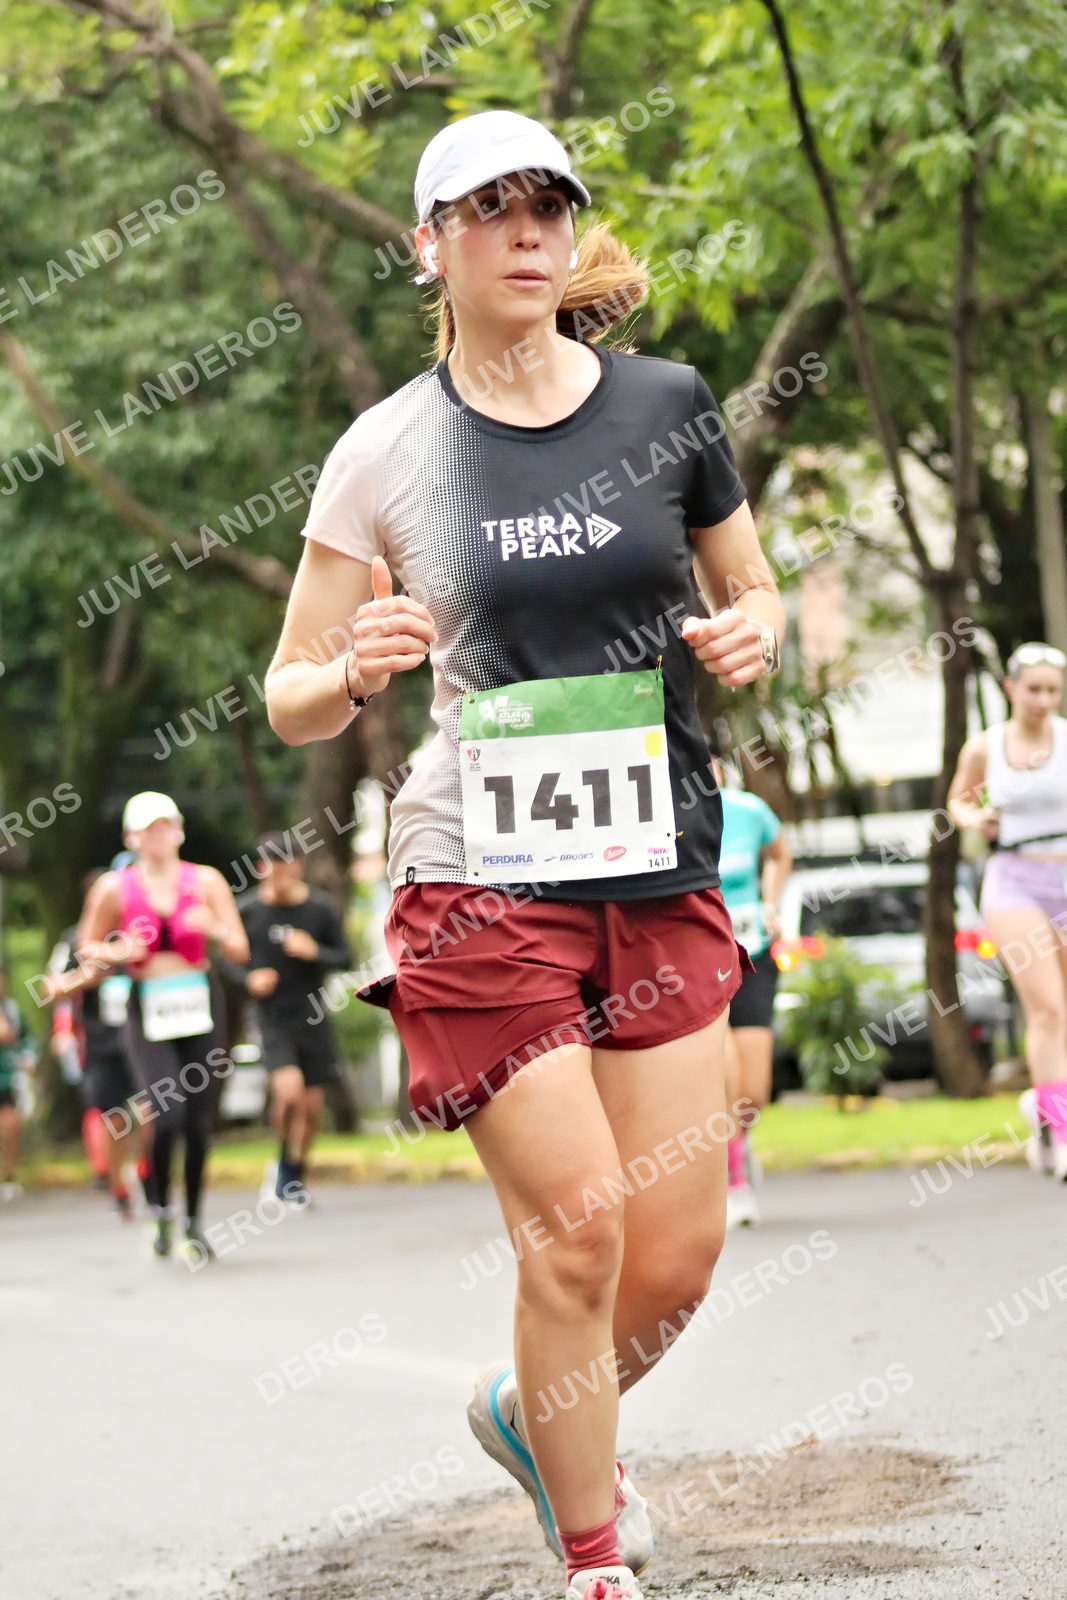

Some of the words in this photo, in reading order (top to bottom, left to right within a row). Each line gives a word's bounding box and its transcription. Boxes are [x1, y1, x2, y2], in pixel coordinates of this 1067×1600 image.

[481, 513, 583, 542] TERRA
[501, 532, 586, 561] PEAK
[484, 764, 653, 834] 1411
[482, 854, 533, 865] PERDURA
[559, 853, 594, 862] BROOKS
[648, 856, 670, 868] 1411
